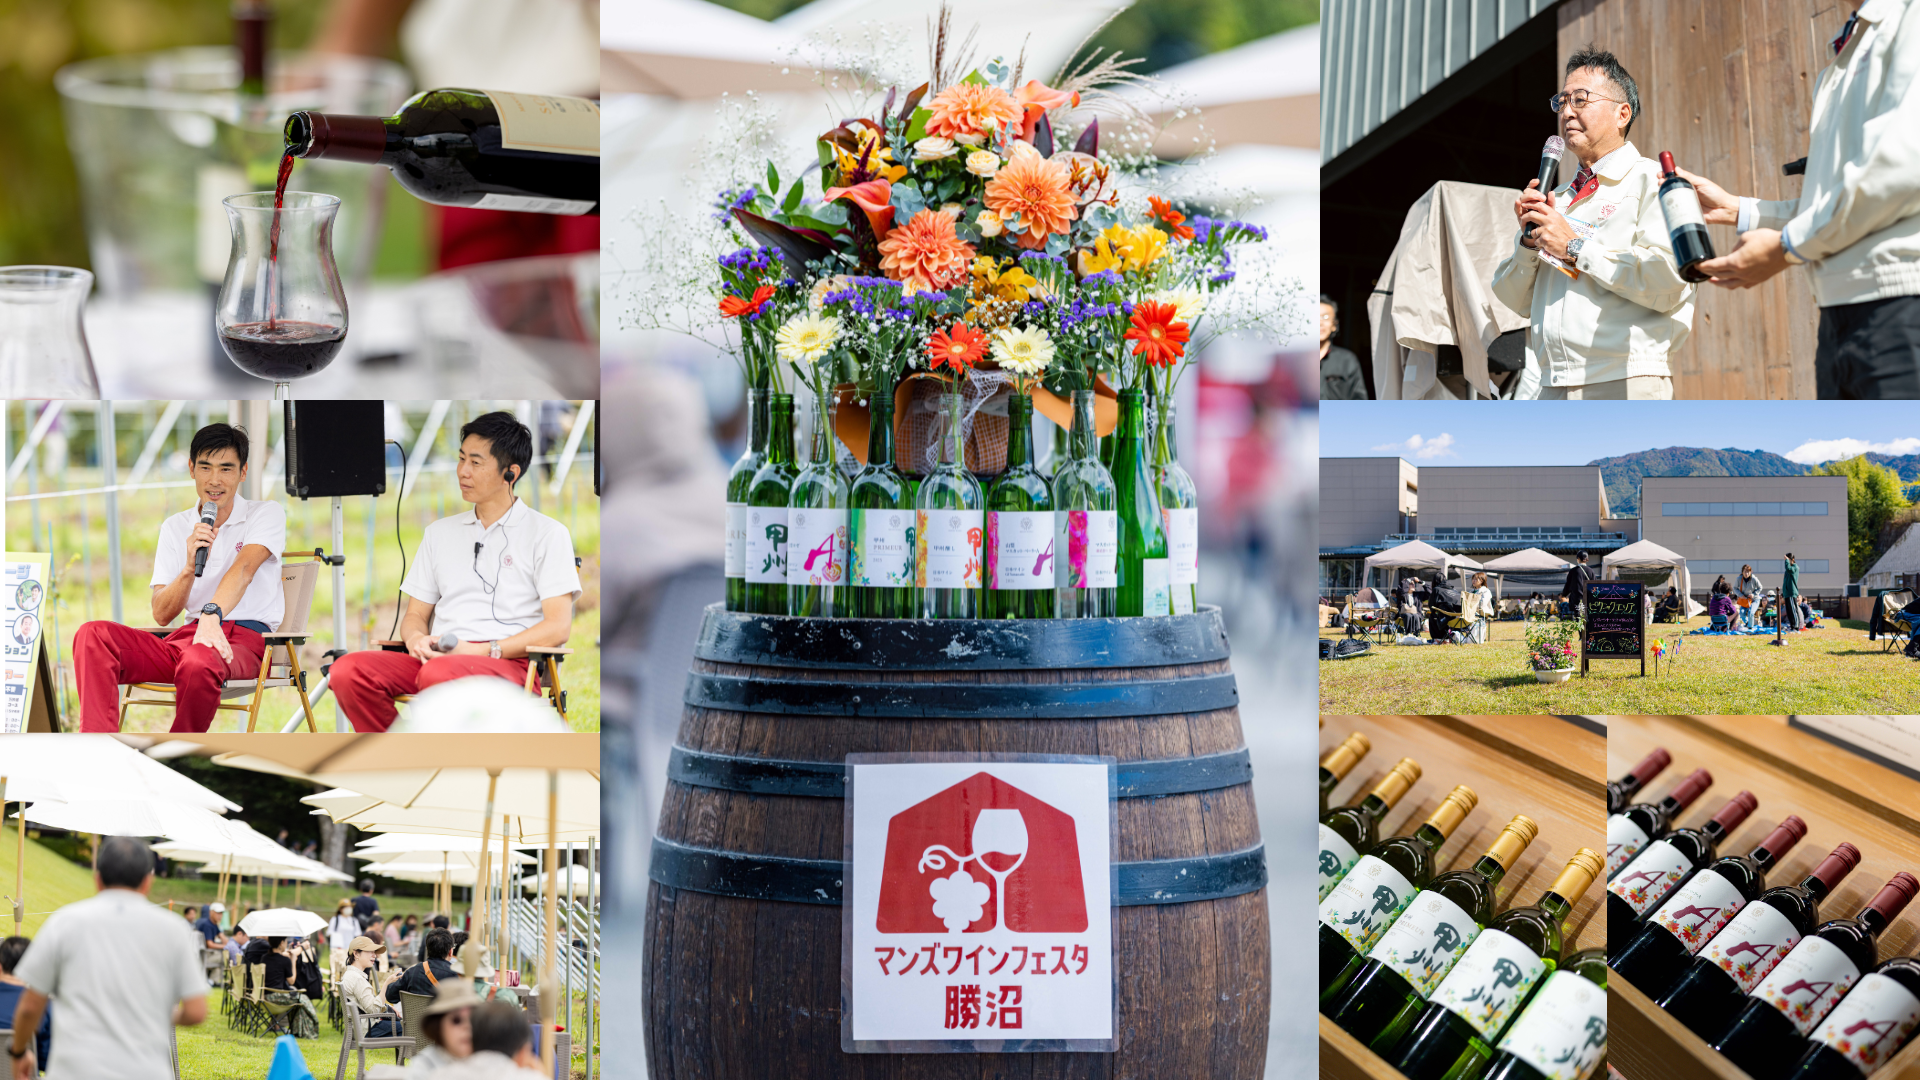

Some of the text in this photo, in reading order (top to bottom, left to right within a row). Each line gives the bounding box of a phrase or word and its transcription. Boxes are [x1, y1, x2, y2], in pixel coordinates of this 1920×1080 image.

[803, 532, 836, 571] A
[963, 526, 983, 580] 甲州
[1620, 870, 1667, 894] A
[1342, 885, 1399, 944] 甲州
[1398, 920, 1425, 936] PRIMEUR
[1672, 904, 1721, 932] A
[874, 942, 1089, 976] マンズワインフェスタ
[1403, 922, 1461, 985] 甲州
[1725, 940, 1776, 971] A
[944, 984, 1023, 1030] 勝沼
[1461, 957, 1523, 1023] 甲州
[1781, 978, 1834, 1011] A
[1843, 1018, 1899, 1052] A
